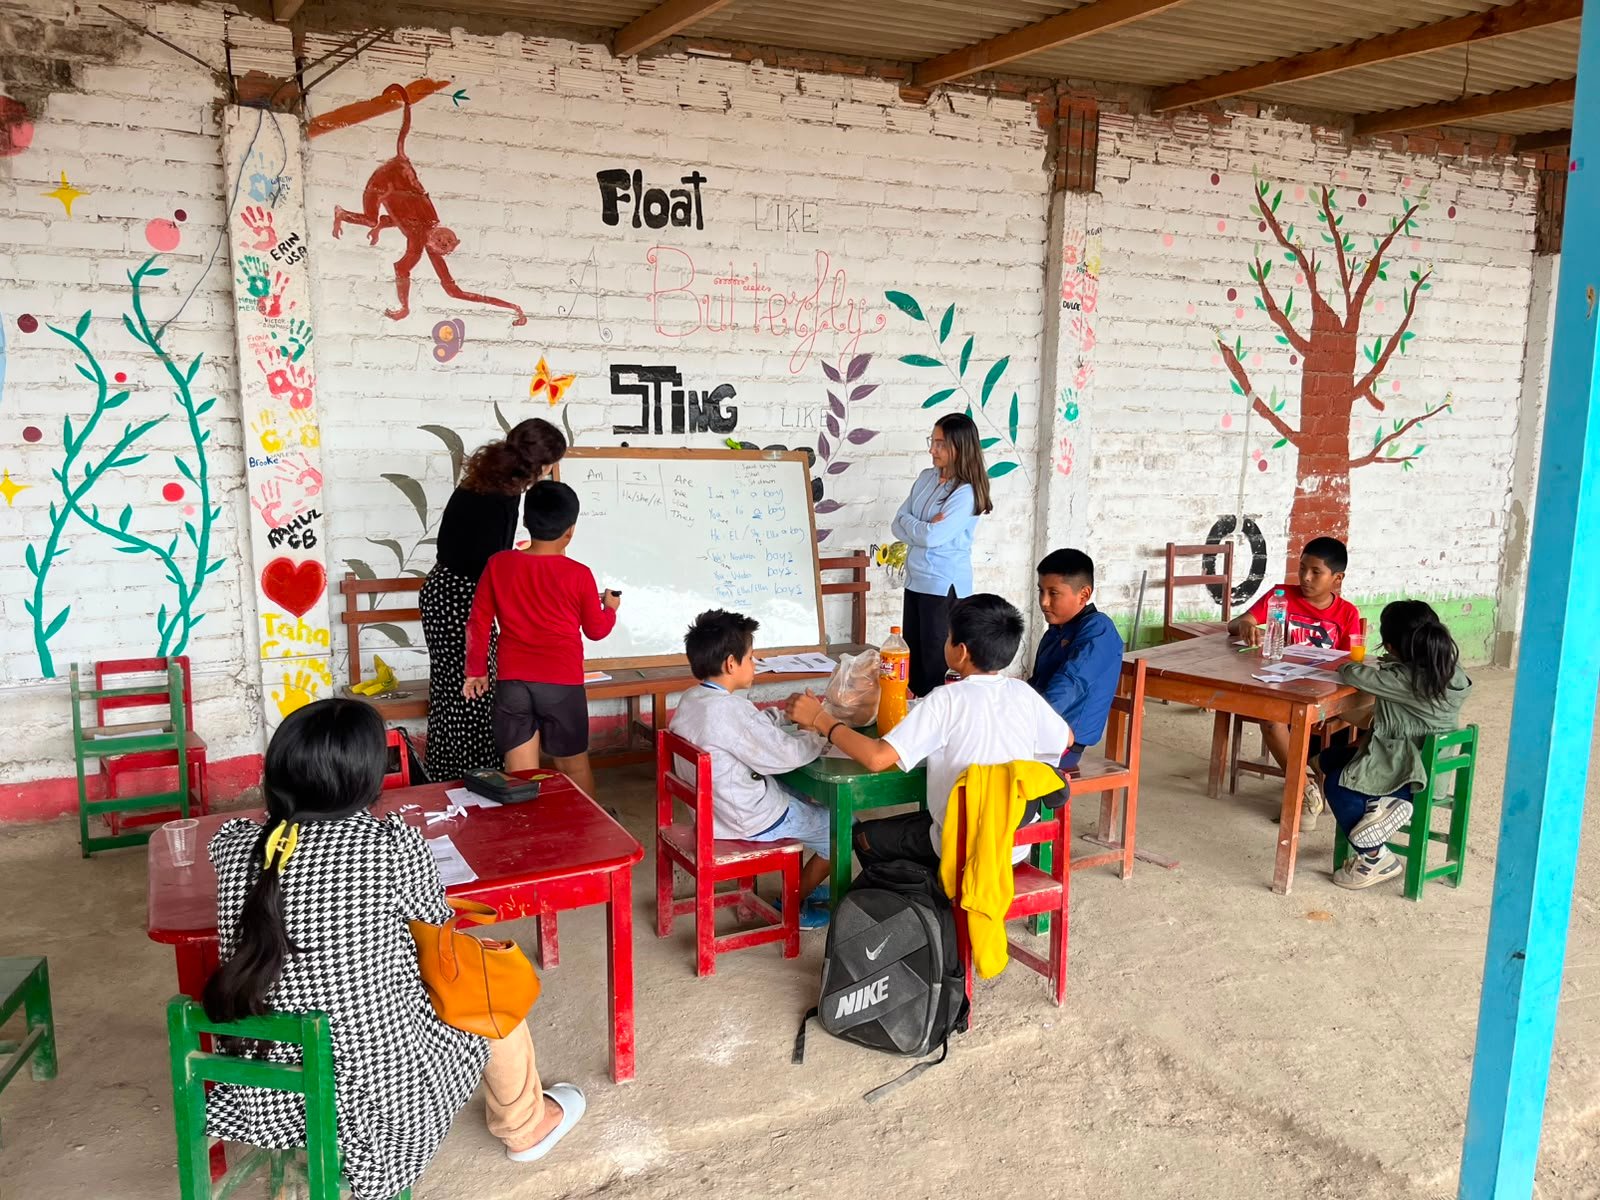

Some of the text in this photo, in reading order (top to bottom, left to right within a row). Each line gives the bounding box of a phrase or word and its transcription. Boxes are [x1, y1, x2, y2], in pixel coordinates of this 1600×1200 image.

[596, 169, 707, 230] Float
[754, 197, 819, 233] LIKE
[270, 232, 300, 261] ERIN
[285, 246, 307, 266] USA
[646, 246, 886, 374] Butterfly
[780, 407, 831, 428] LIKE
[248, 455, 279, 468] Brooke
[587, 468, 604, 480] Am
[674, 474, 694, 487] Are
[763, 487, 784, 505] boy
[670, 509, 695, 528] They
[767, 503, 786, 522] boy
[268, 509, 323, 548] RAHUL
[766, 547, 793, 566] boys
[775, 582, 803, 597] boys
[261, 613, 330, 648] Taha
[834, 976, 889, 1020] NIKE
